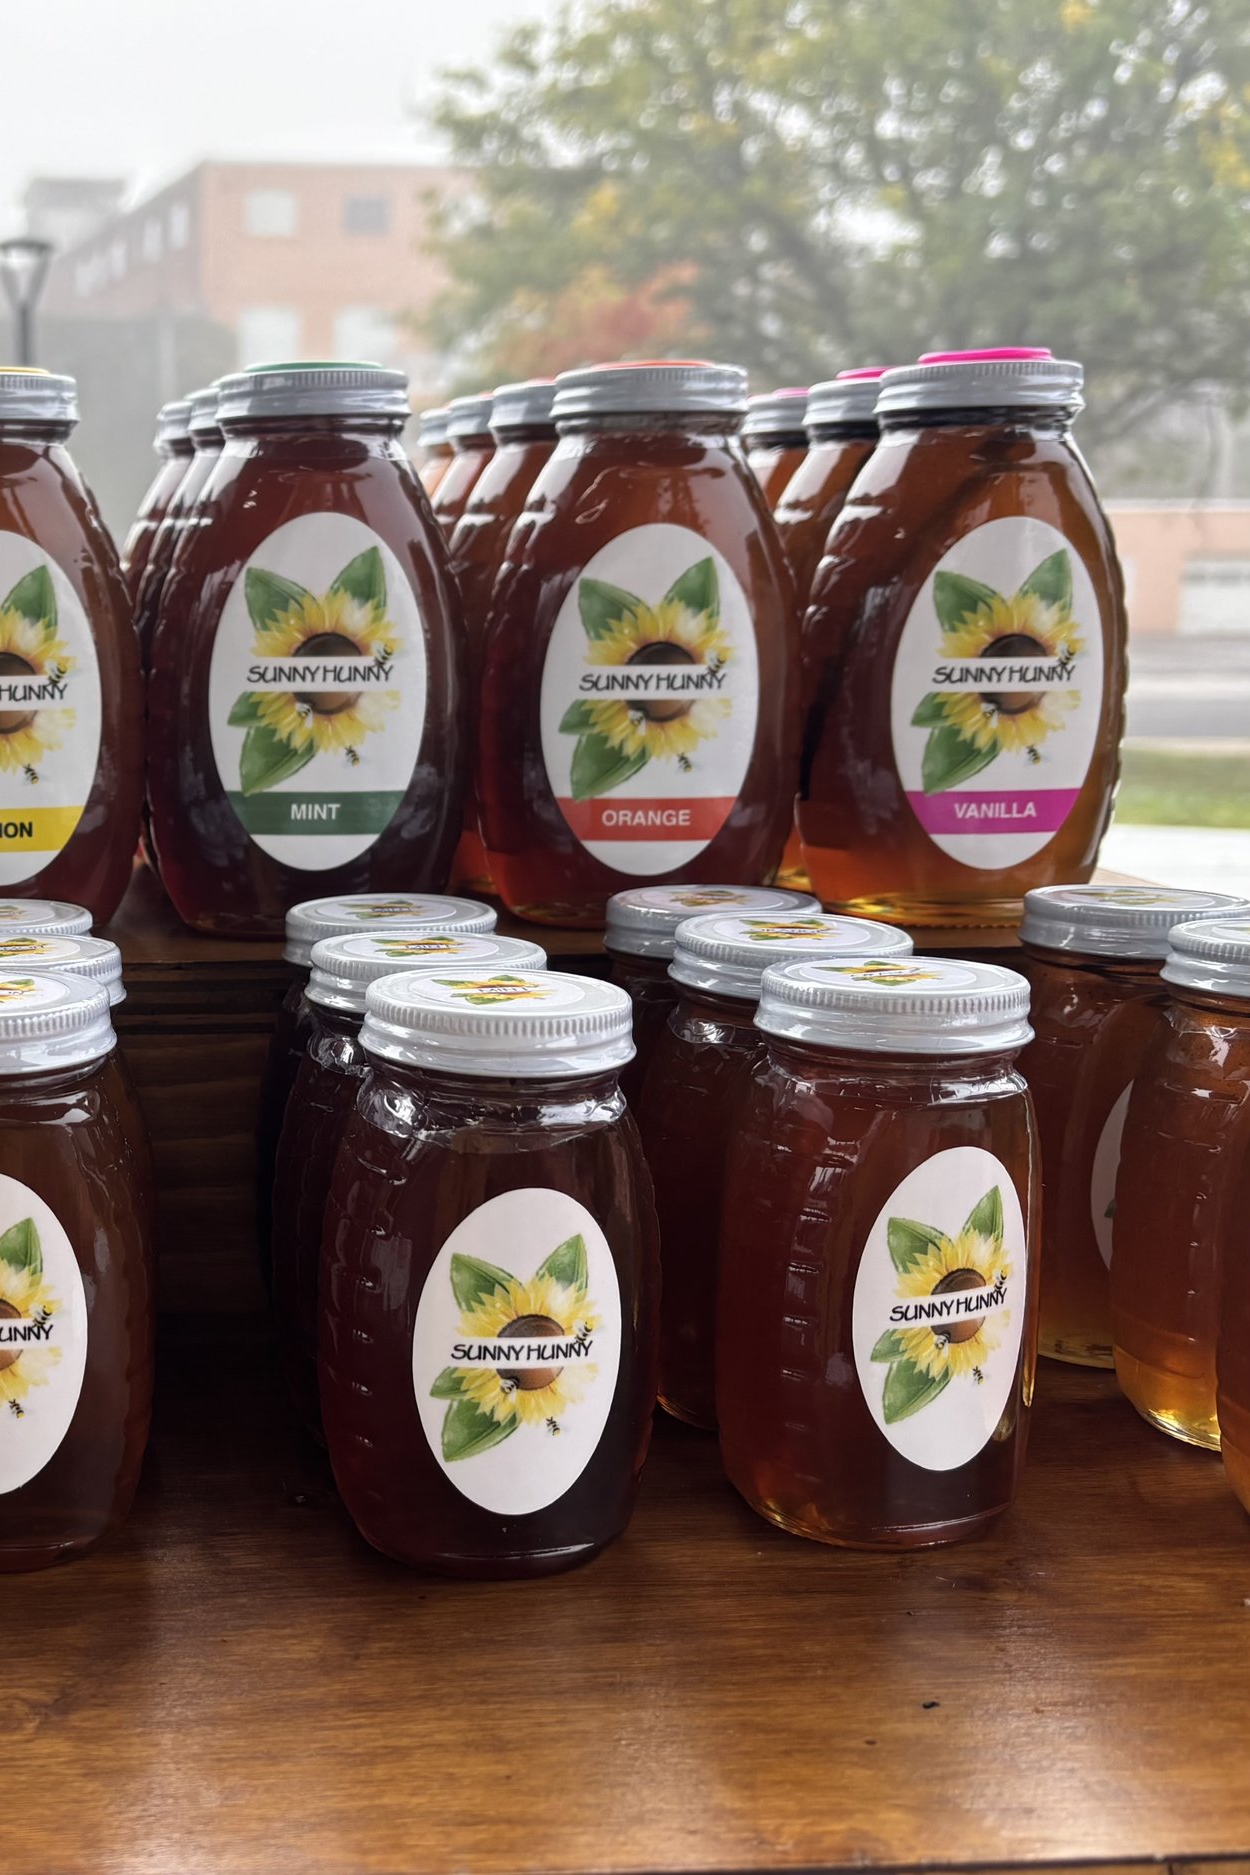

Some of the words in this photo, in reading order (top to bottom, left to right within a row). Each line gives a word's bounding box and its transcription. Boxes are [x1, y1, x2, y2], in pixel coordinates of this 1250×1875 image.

[246, 665, 321, 684] SUNNY
[322, 664, 394, 684] HUNNY
[579, 673, 654, 692] SUNNY
[655, 672, 727, 692] HUNNY
[931, 665, 1007, 684] SUNNY
[1008, 664, 1076, 683] HUNNY
[290, 803, 341, 821] MINT
[601, 809, 692, 828] ORANGE
[953, 801, 1038, 819] VANILLA
[889, 1299, 955, 1322] SUNNY
[955, 1287, 1008, 1315] HUNNY
[450, 1343, 525, 1362] SUNNY
[526, 1340, 594, 1361] HUNNY
